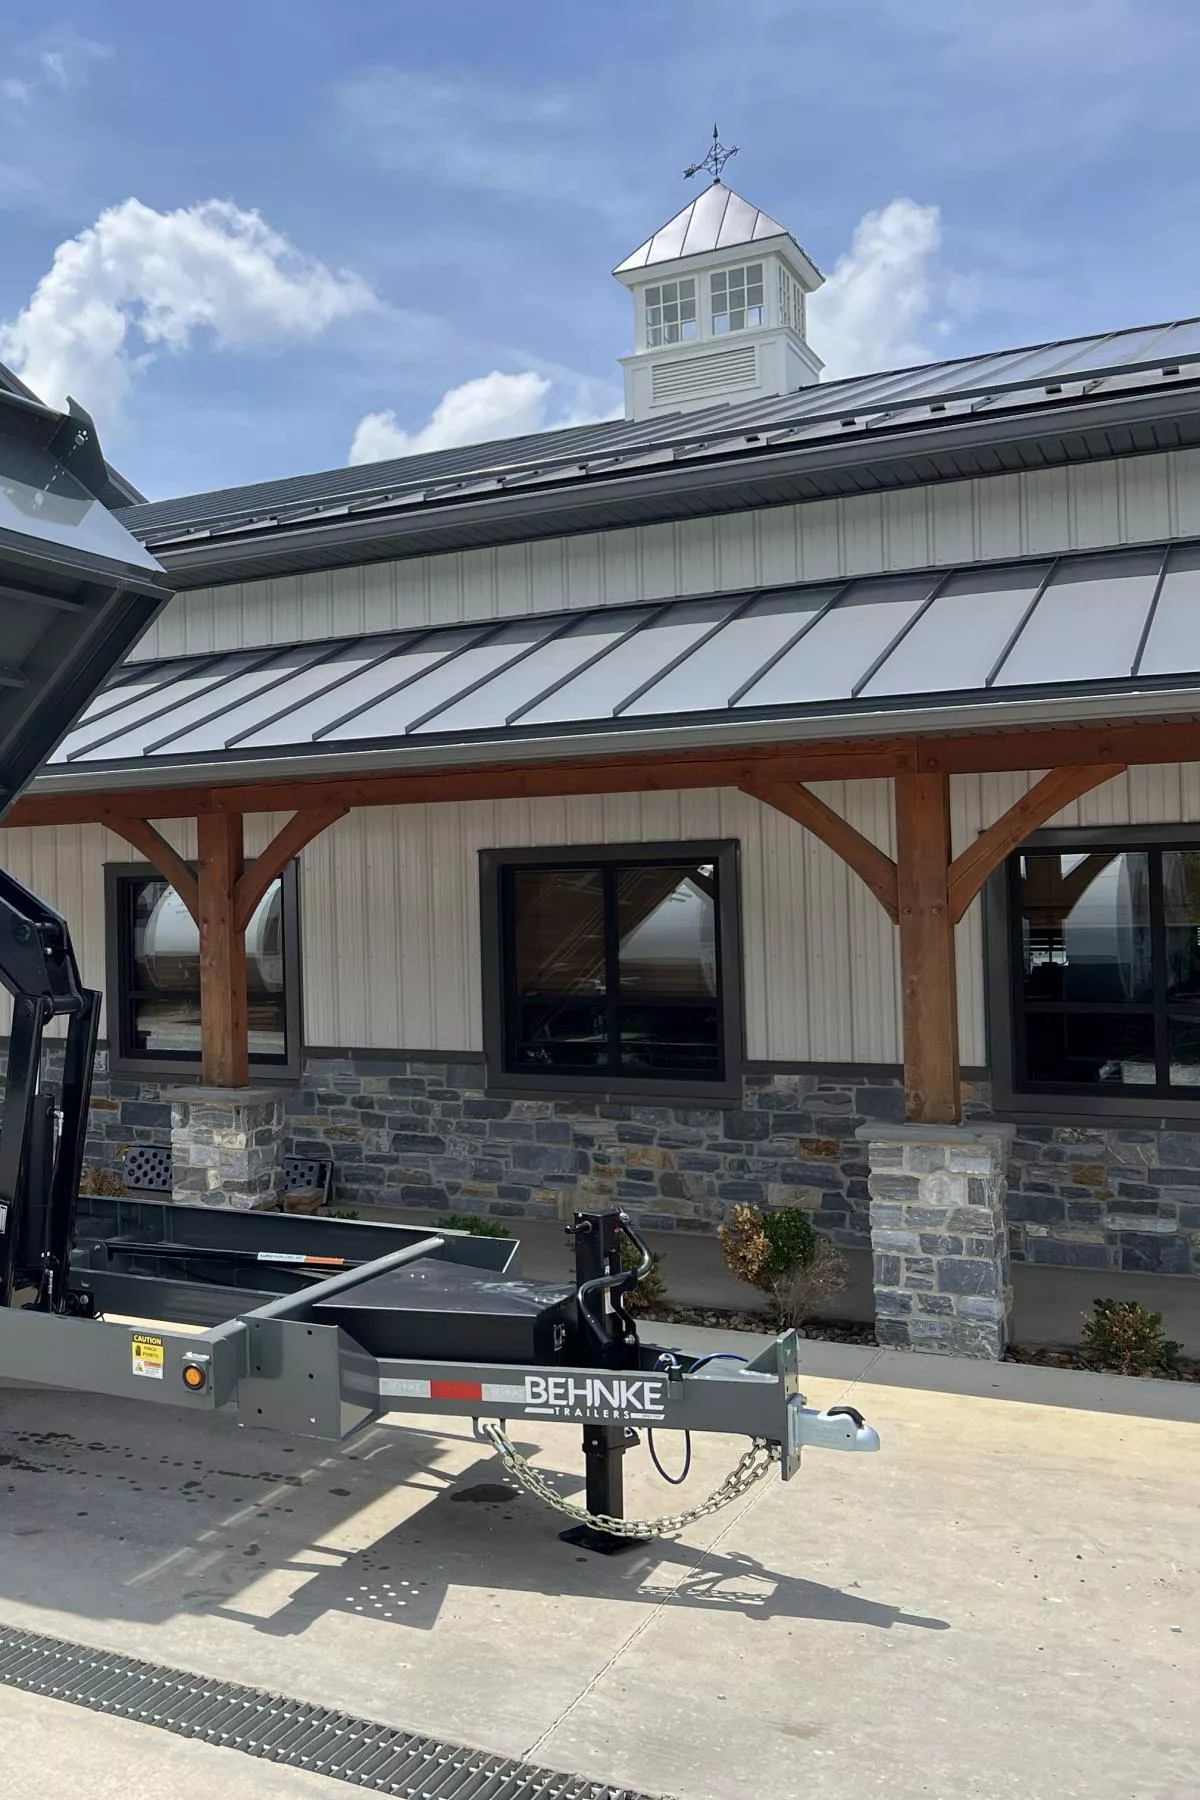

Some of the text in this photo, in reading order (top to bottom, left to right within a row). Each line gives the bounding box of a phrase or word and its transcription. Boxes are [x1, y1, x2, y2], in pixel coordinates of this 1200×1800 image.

[133, 1335, 162, 1345] CAUTION
[524, 1376, 665, 1411] BEHNKE
[554, 1407, 631, 1419] TRAILERS
